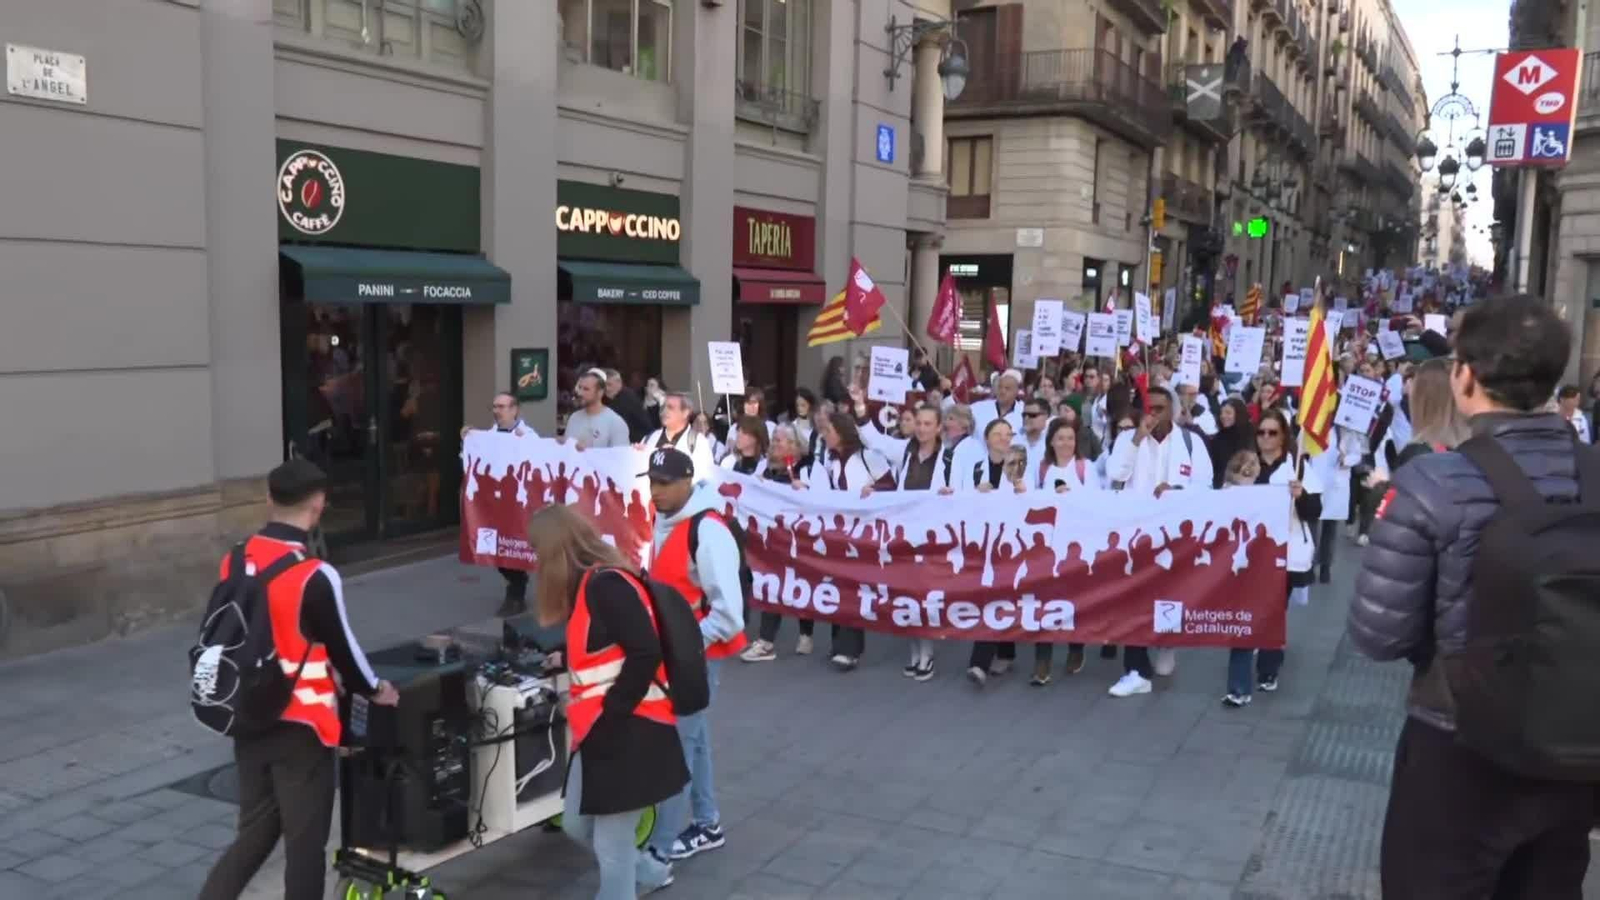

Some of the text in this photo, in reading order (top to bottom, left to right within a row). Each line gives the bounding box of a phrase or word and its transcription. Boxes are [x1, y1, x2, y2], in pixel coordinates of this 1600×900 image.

[43, 67, 54, 78] DE
[1518, 66, 1541, 85] M
[358, 284, 472, 298] PANINI FOCACCIA
[597, 288, 681, 300] BAKERY ICED COFFEE
[1349, 383, 1377, 398] STOP
[1185, 609, 1252, 622] Metges de
[1185, 622, 1252, 638] Catalunya
